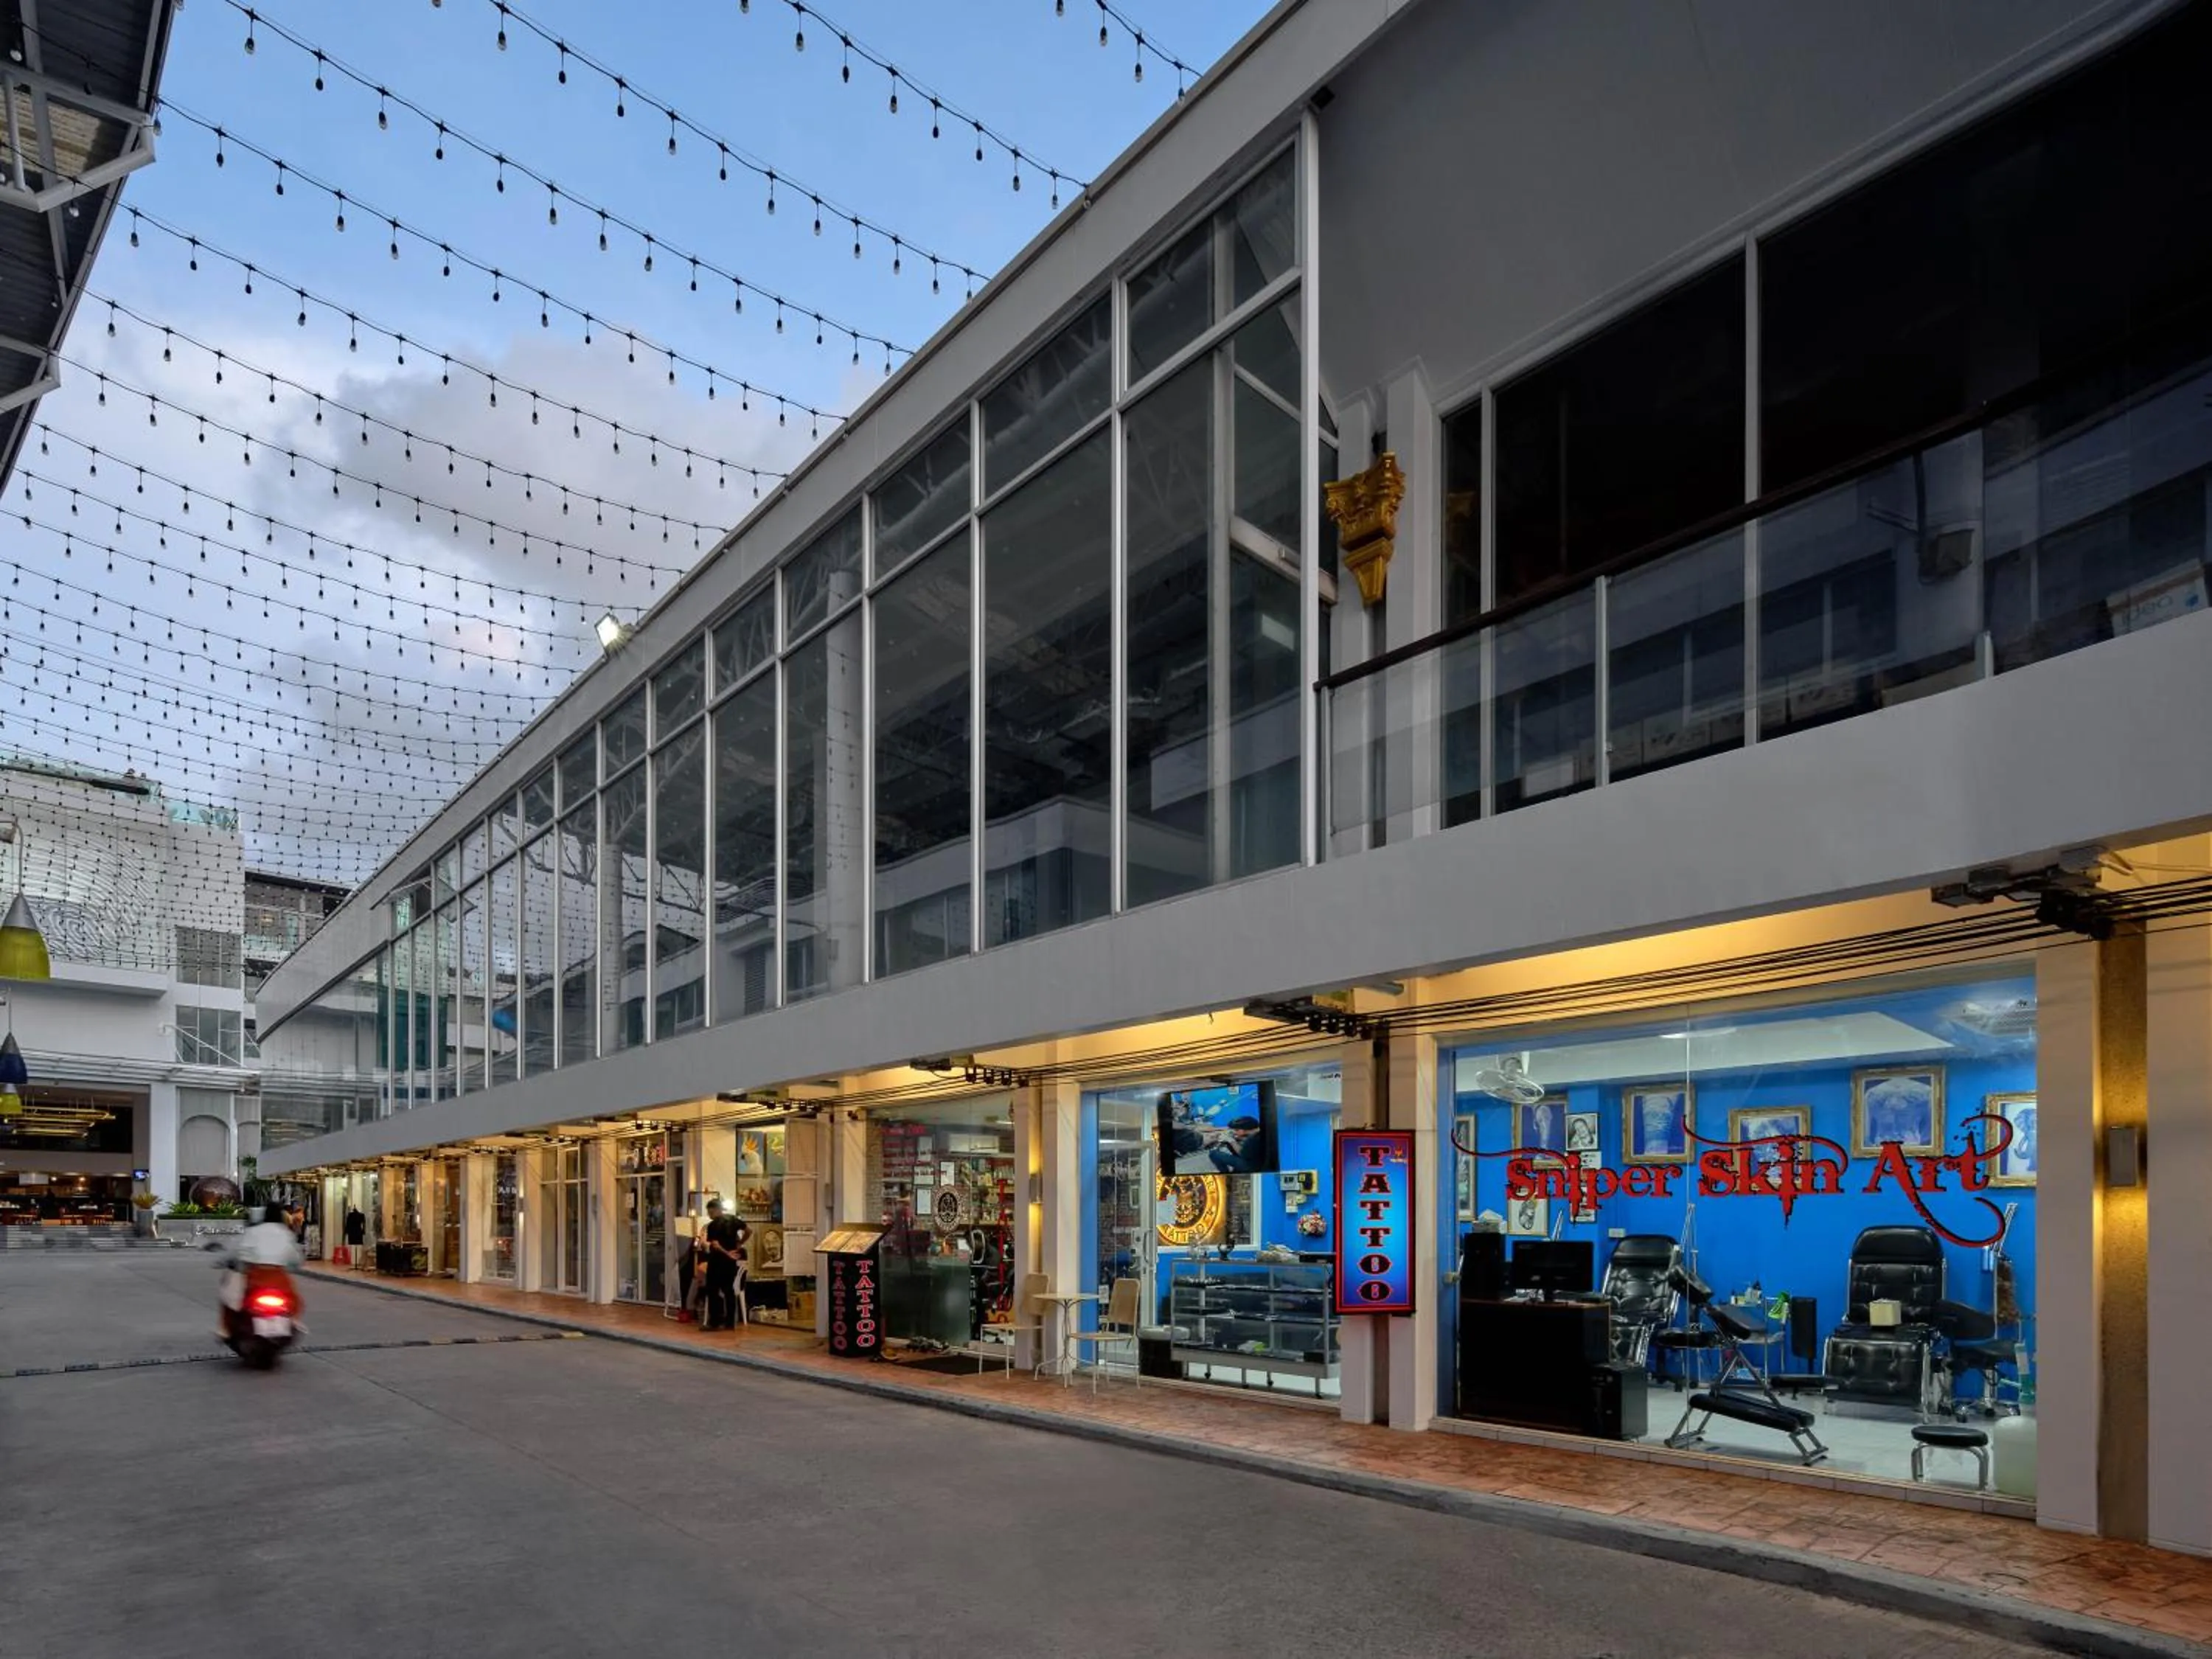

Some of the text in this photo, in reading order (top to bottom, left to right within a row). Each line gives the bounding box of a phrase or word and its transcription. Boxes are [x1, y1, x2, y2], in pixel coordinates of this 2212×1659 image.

[1357, 1146, 1392, 1302] TATTOO
[1450, 1110, 2014, 1248] Sniper Skin Art
[832, 1260, 847, 1350] TATTOO
[855, 1260, 875, 1347] TATTOO
